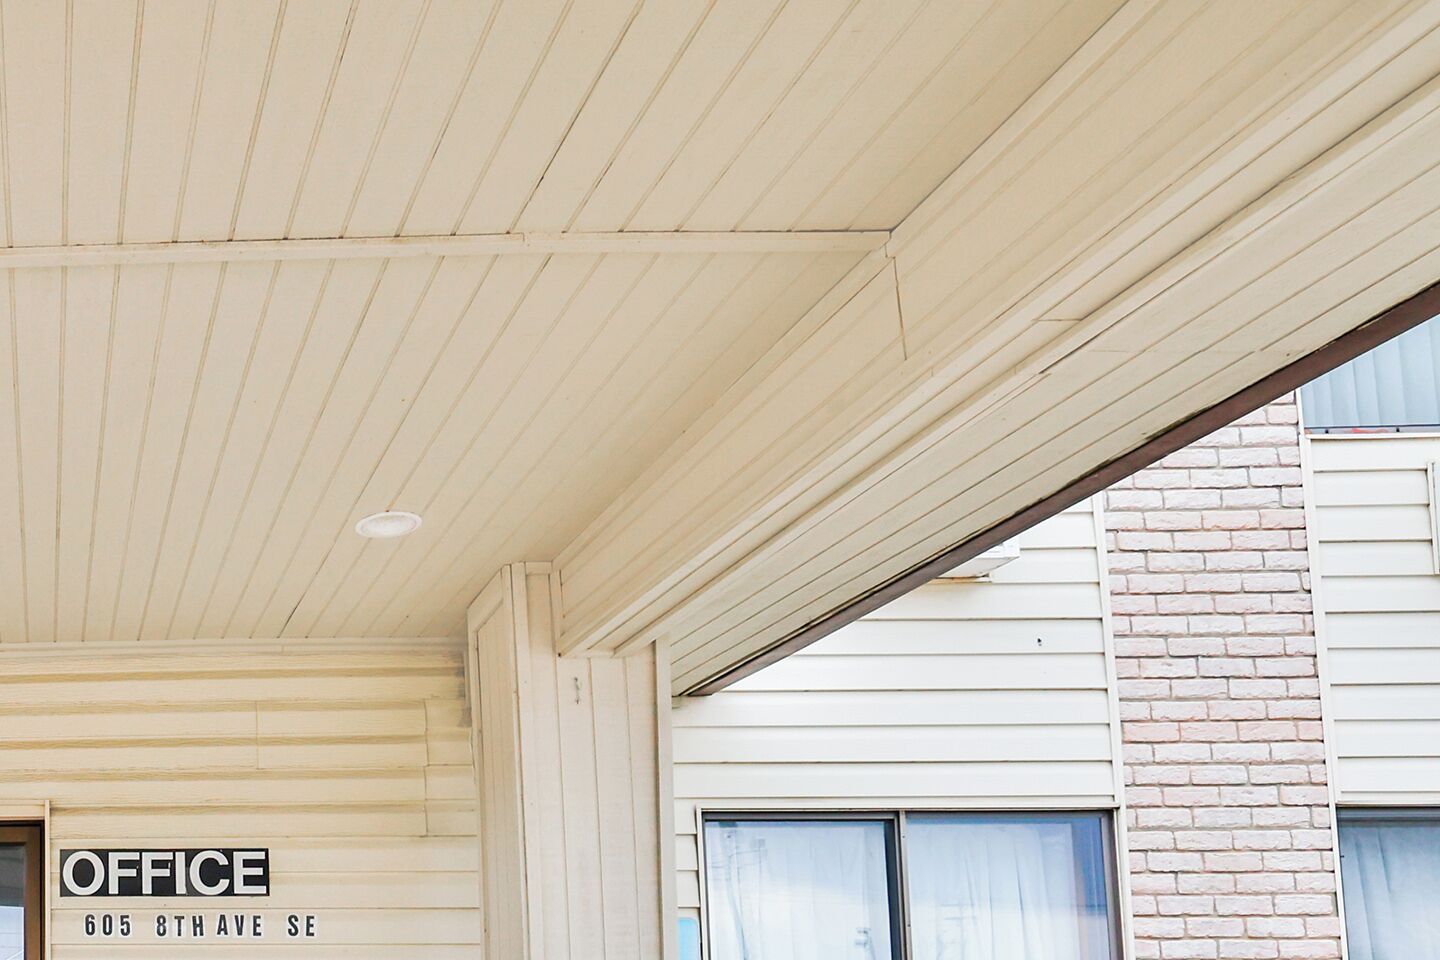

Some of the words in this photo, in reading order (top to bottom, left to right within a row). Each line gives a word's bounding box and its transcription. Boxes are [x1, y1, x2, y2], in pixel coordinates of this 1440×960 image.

[62, 849, 267, 896] OFFICE
[84, 913, 131, 936] 605
[156, 914, 204, 937] 8TH
[216, 914, 262, 937] AVE
[287, 914, 316, 937] SE
